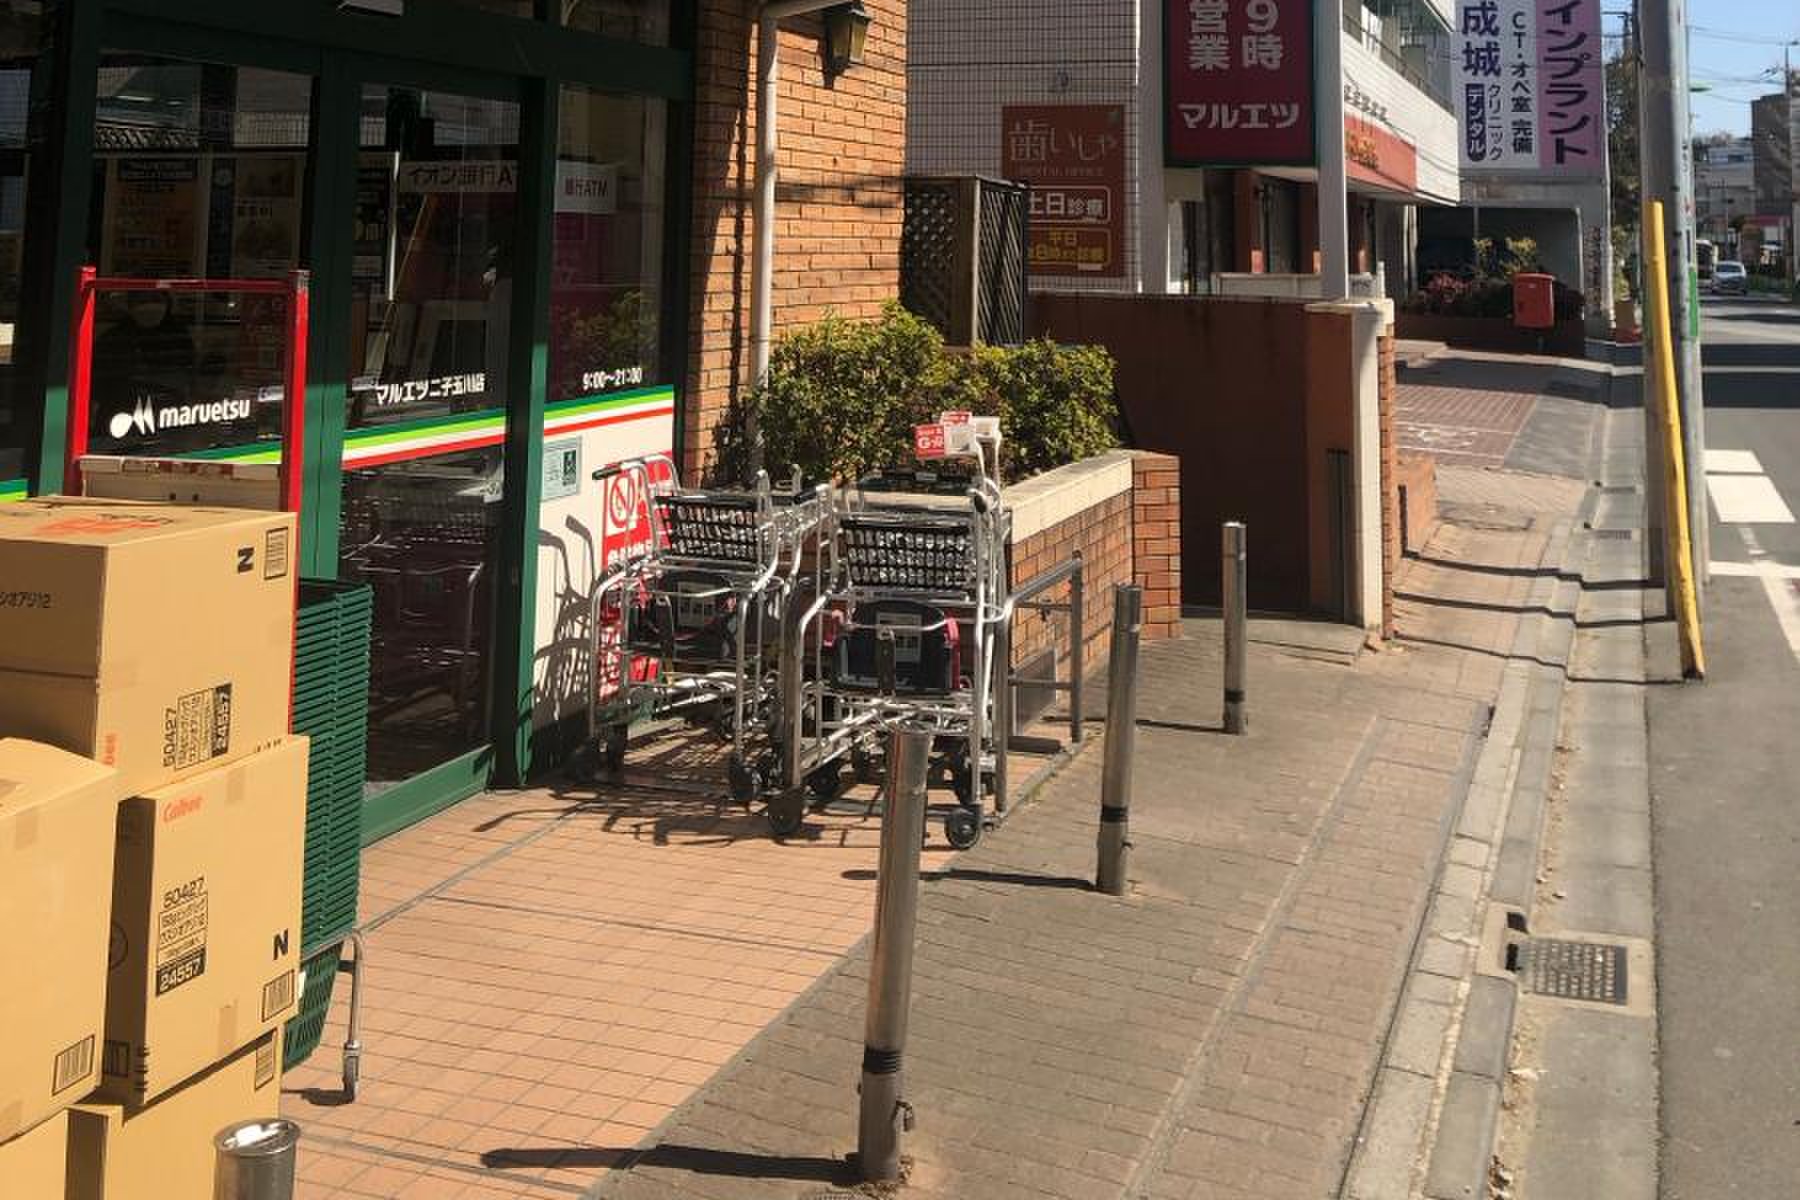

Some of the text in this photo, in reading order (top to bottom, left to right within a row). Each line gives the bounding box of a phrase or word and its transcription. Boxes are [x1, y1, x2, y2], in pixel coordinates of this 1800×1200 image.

[1462, 0, 1502, 76] 成城
[1178, 103, 1299, 128] マルエツ
[1543, 0, 1593, 164] インプラント
[1487, 83, 1503, 161] クリニック
[159, 400, 250, 429] maruetsu
